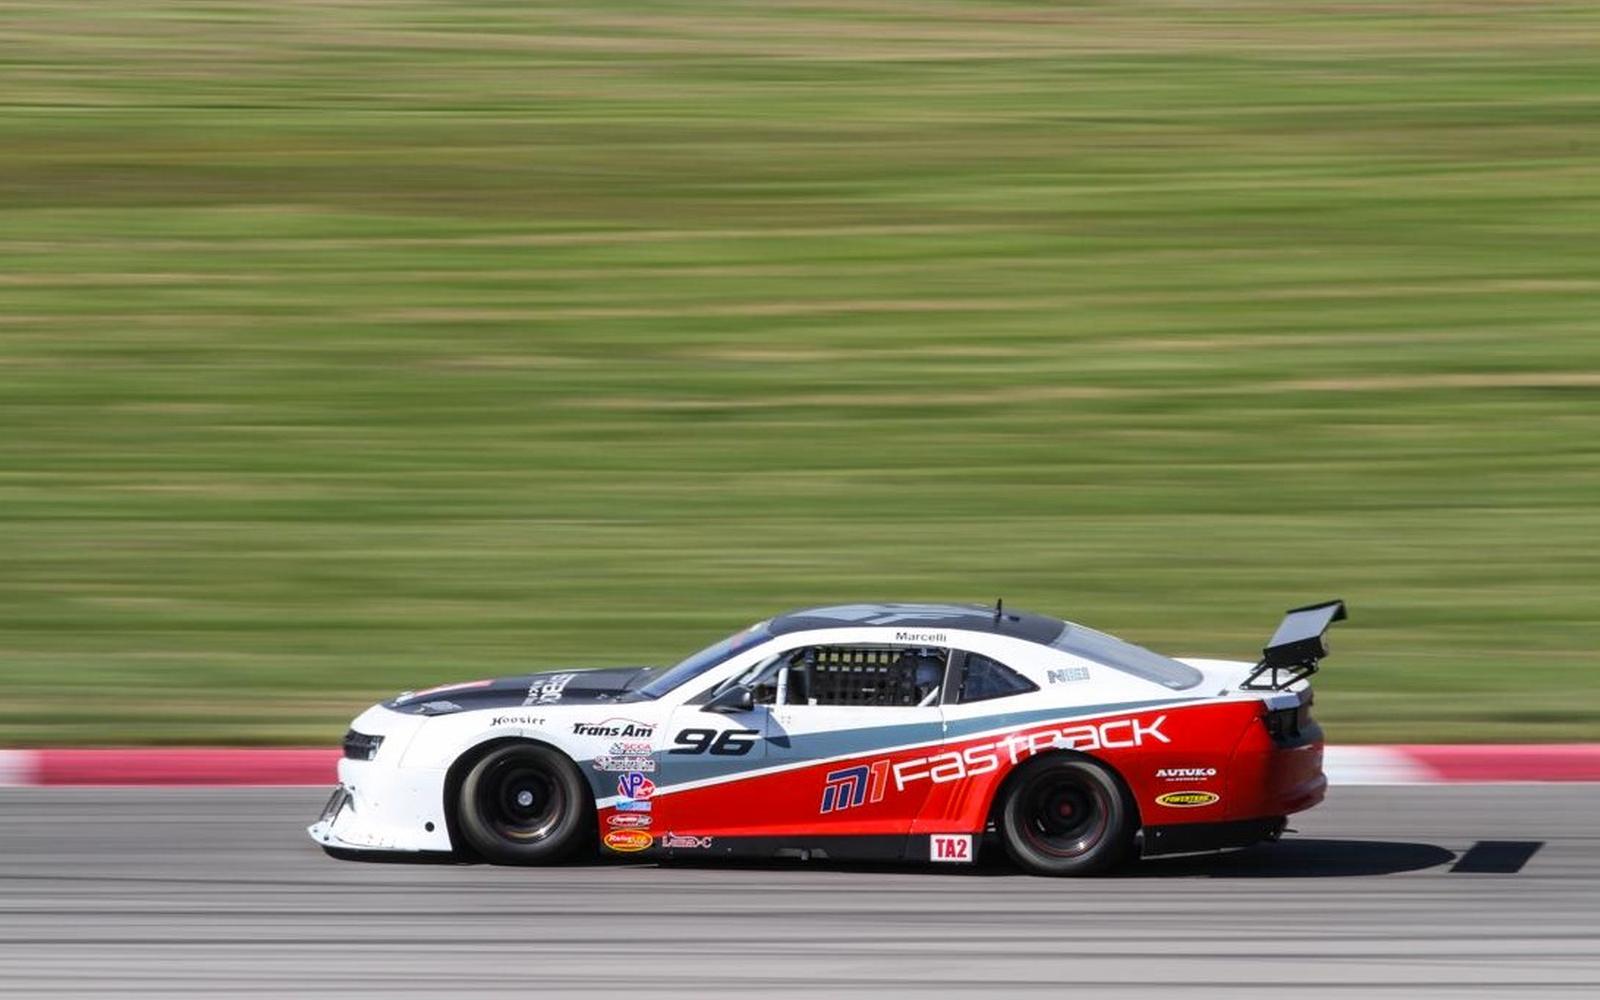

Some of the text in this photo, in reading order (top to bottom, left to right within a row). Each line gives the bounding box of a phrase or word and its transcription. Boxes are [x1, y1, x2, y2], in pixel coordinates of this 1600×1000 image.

[896, 631, 946, 642] Marcelli
[490, 715, 546, 727] Hoosier
[573, 722, 653, 737] Trans Am
[668, 728, 760, 756] 96
[619, 771, 644, 799] VP
[935, 838, 967, 858] TA2
